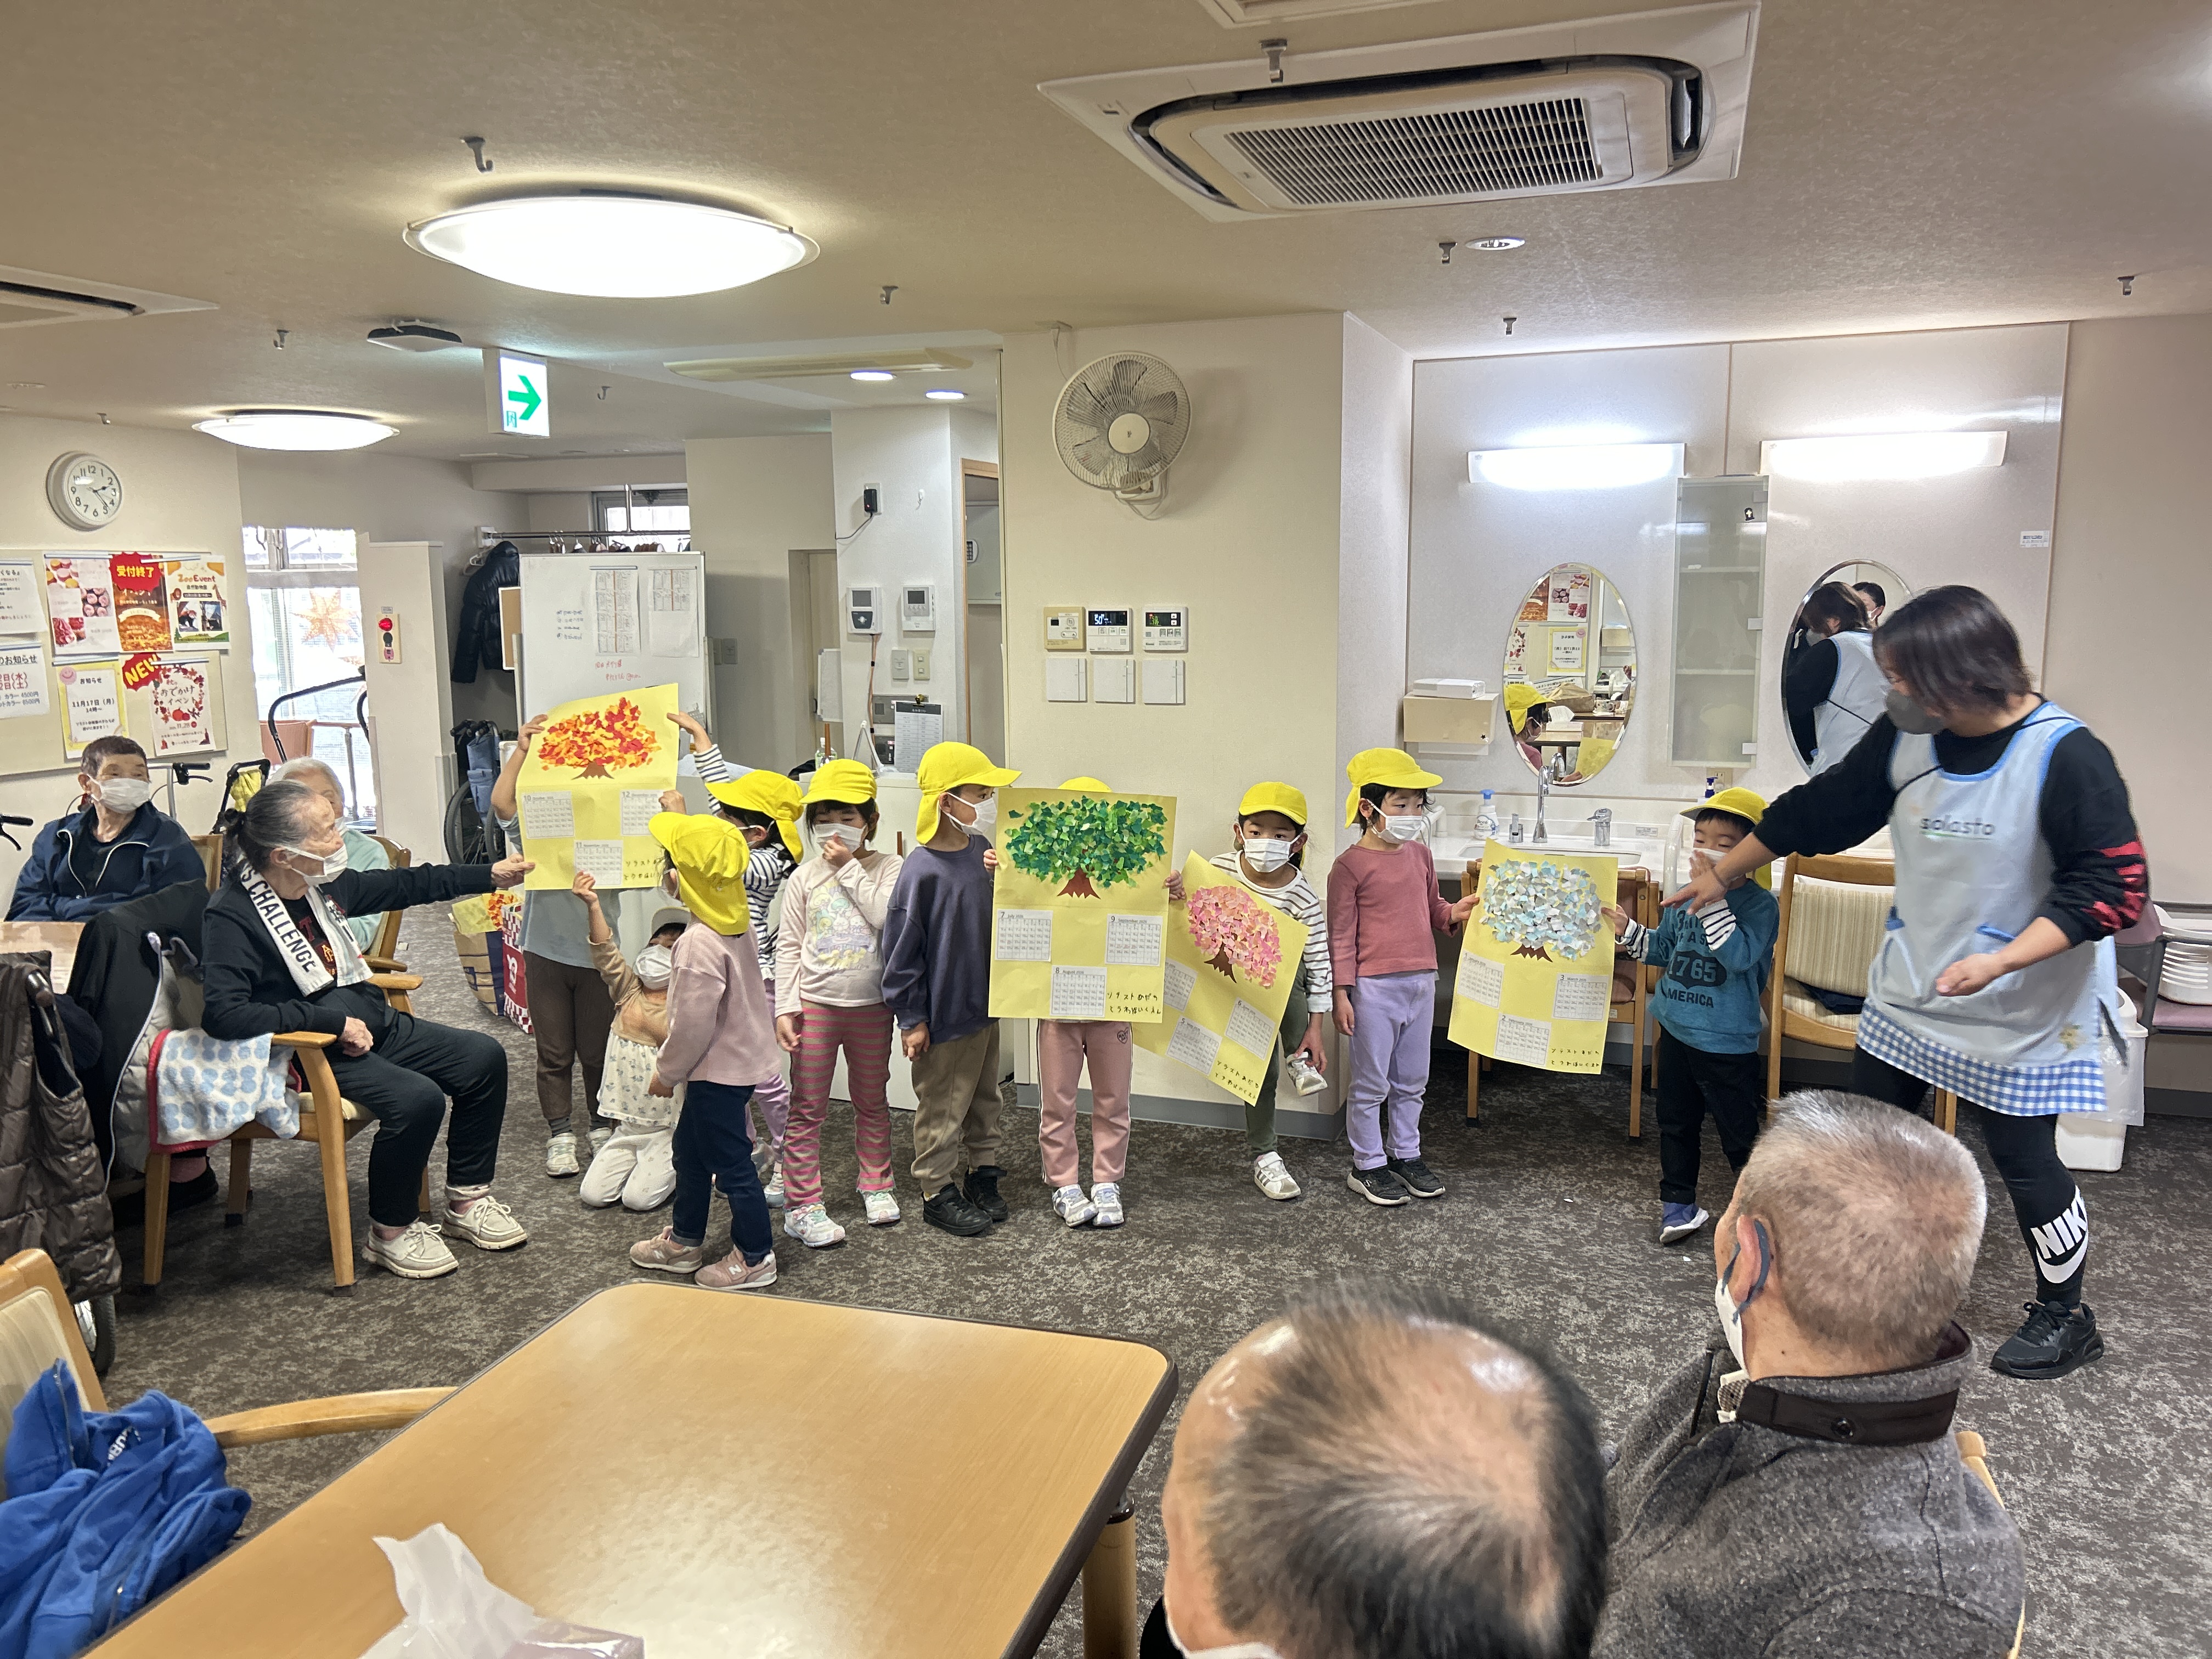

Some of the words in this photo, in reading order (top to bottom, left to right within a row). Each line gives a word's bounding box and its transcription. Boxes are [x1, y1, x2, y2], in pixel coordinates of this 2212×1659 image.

[88, 465, 96, 473] 12
[100, 469, 104, 477] 1
[108, 477, 113, 486] 2
[75, 496, 81, 506] 8
[83, 505, 89, 513] 7
[93, 509, 98, 517] 6
[116, 566, 154, 578] 受付終了
[247, 880, 317, 973] CHALLENGE
[2030, 1186, 2087, 1259] NIK
[728, 1264, 742, 1275] N
